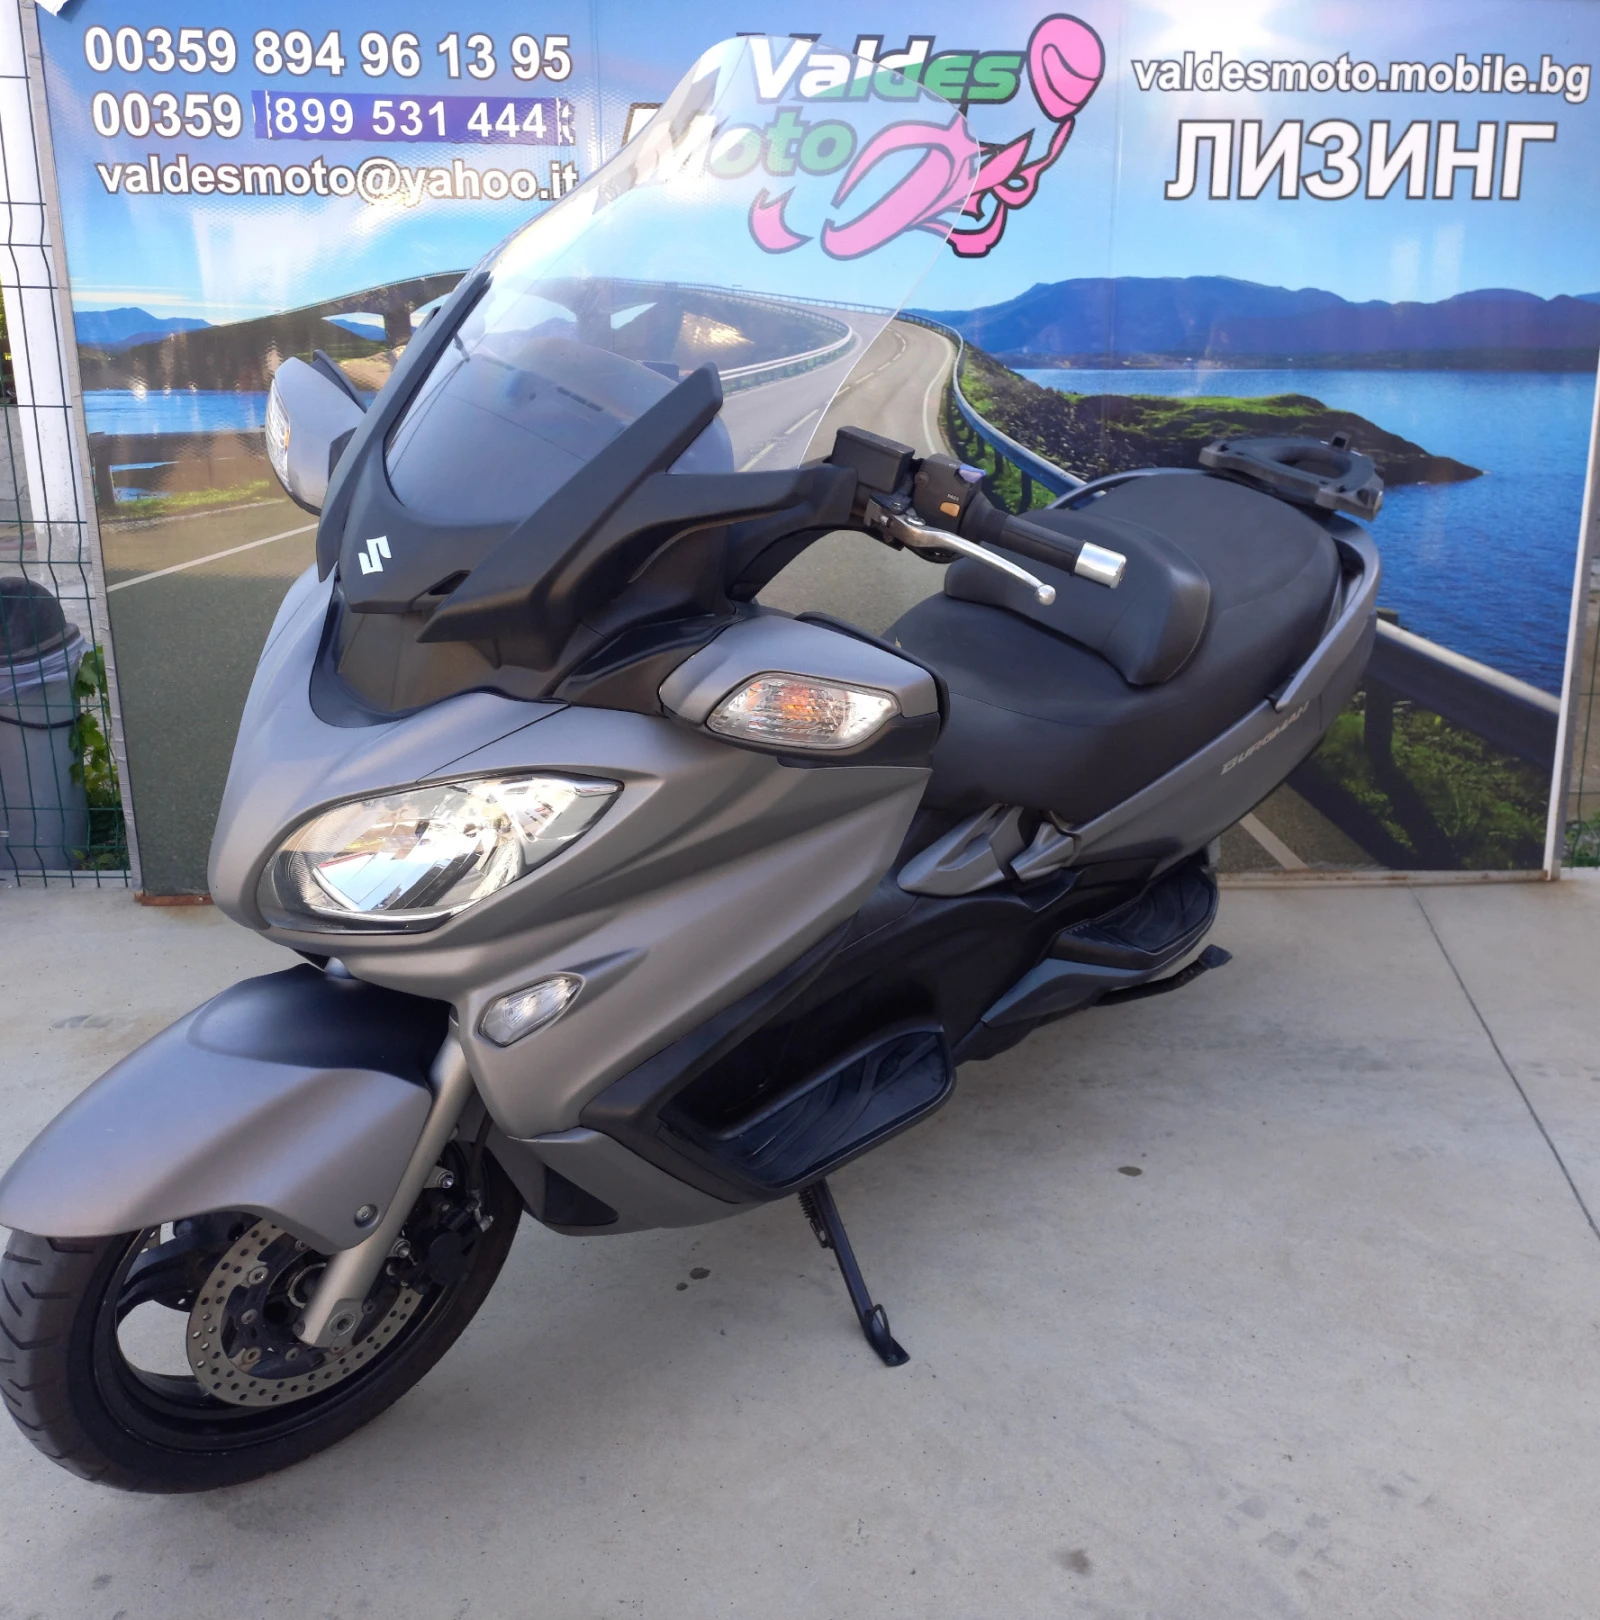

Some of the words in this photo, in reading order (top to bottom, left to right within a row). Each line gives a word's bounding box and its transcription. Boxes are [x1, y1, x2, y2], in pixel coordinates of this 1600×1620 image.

[84, 27, 237, 75] 00359
[253, 30, 346, 77] 894
[360, 33, 420, 78] 96
[437, 34, 497, 80] 13
[510, 35, 573, 81] 95
[737, 33, 1029, 105] Valdes
[1131, 51, 1592, 103] valdesmoto.mobile.bg
[91, 92, 242, 138] 00359
[274, 97, 354, 134] 899
[372, 100, 447, 136] 531
[467, 102, 547, 139] 444
[96, 154, 579, 208] valdesmoto@yahoo.it
[1164, 118, 1558, 201] ЛИЗИНГ
